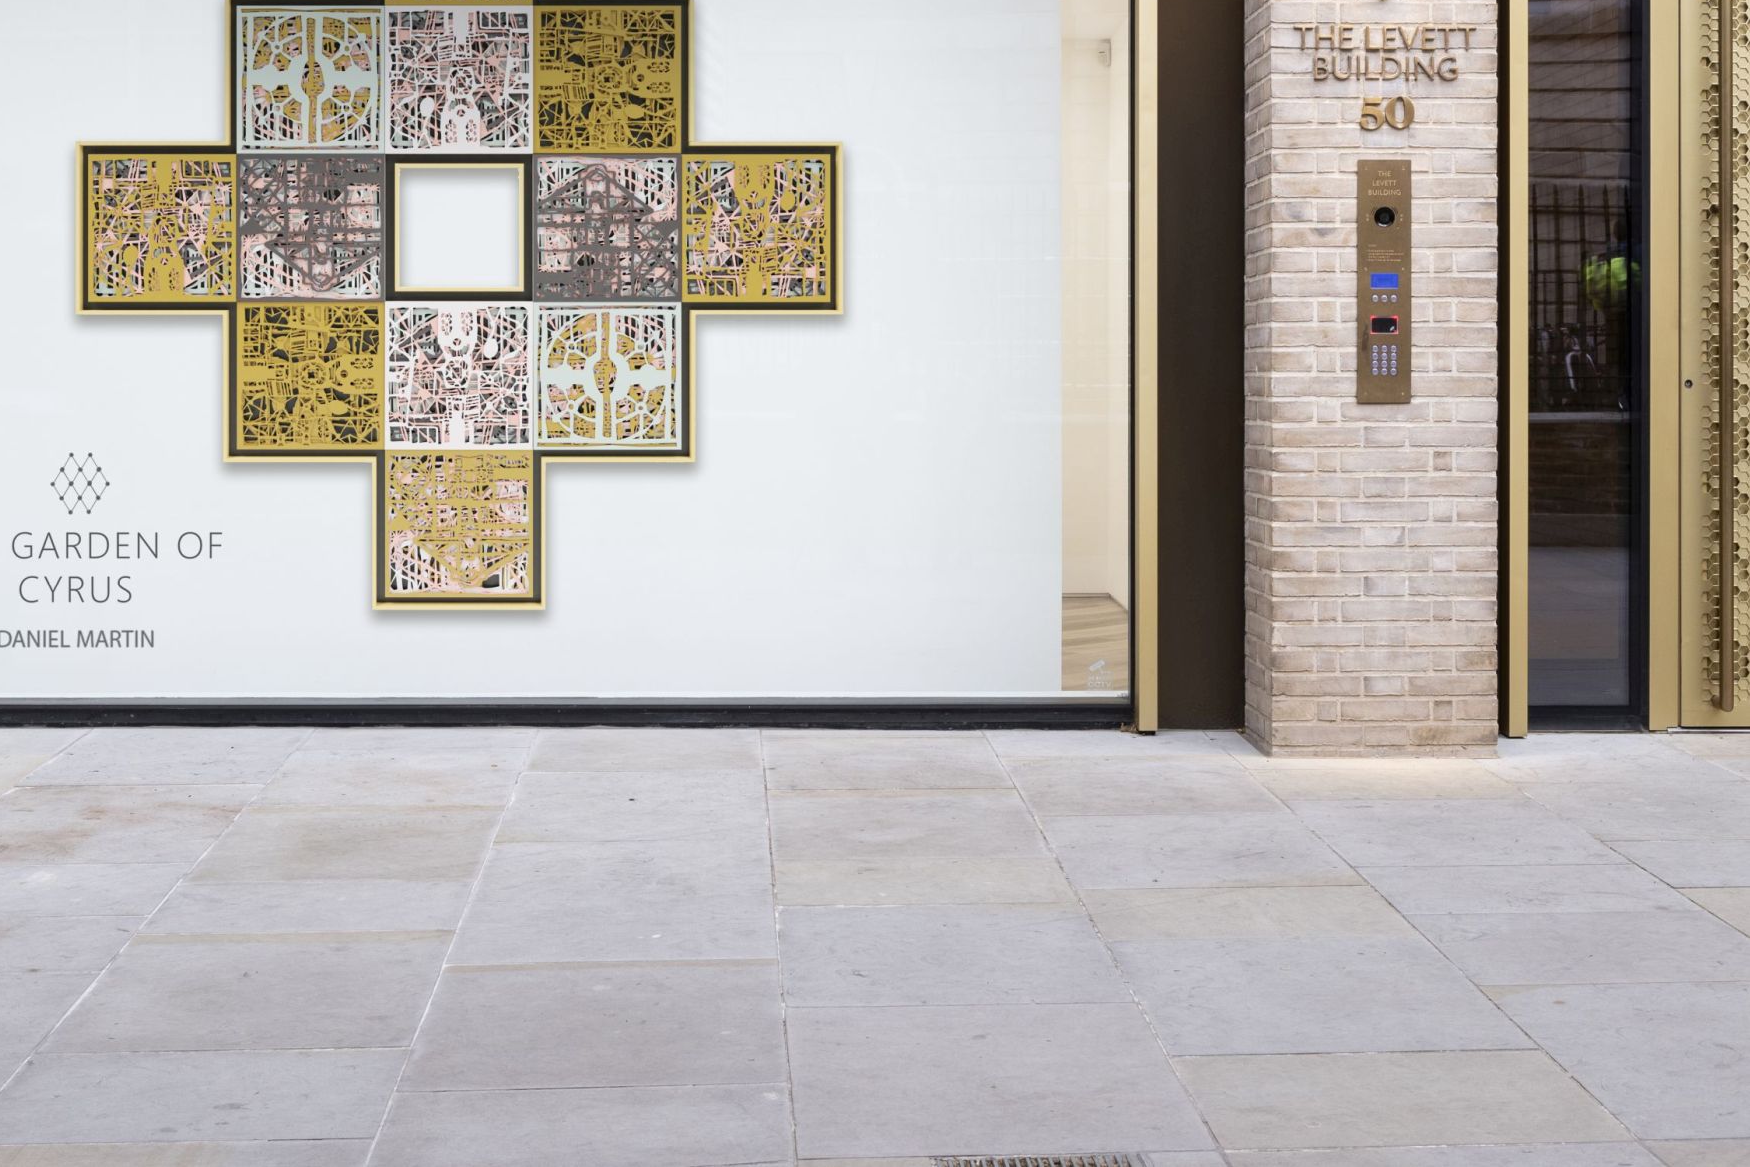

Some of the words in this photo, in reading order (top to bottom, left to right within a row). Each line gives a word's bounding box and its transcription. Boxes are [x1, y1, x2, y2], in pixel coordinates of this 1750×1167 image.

[1293, 25, 1353, 51] THE
[1363, 25, 1477, 52] LEVETT
[1313, 55, 1459, 82] BUILDING
[1359, 96, 1415, 131] 50
[1367, 188, 1402, 197] BUILDING
[1372, 179, 1397, 187] LEVETT
[11, 531, 159, 559] GARDEN
[177, 531, 223, 559] OF
[18, 575, 132, 603] CYRUS
[76, 629, 155, 648] MARTIN
